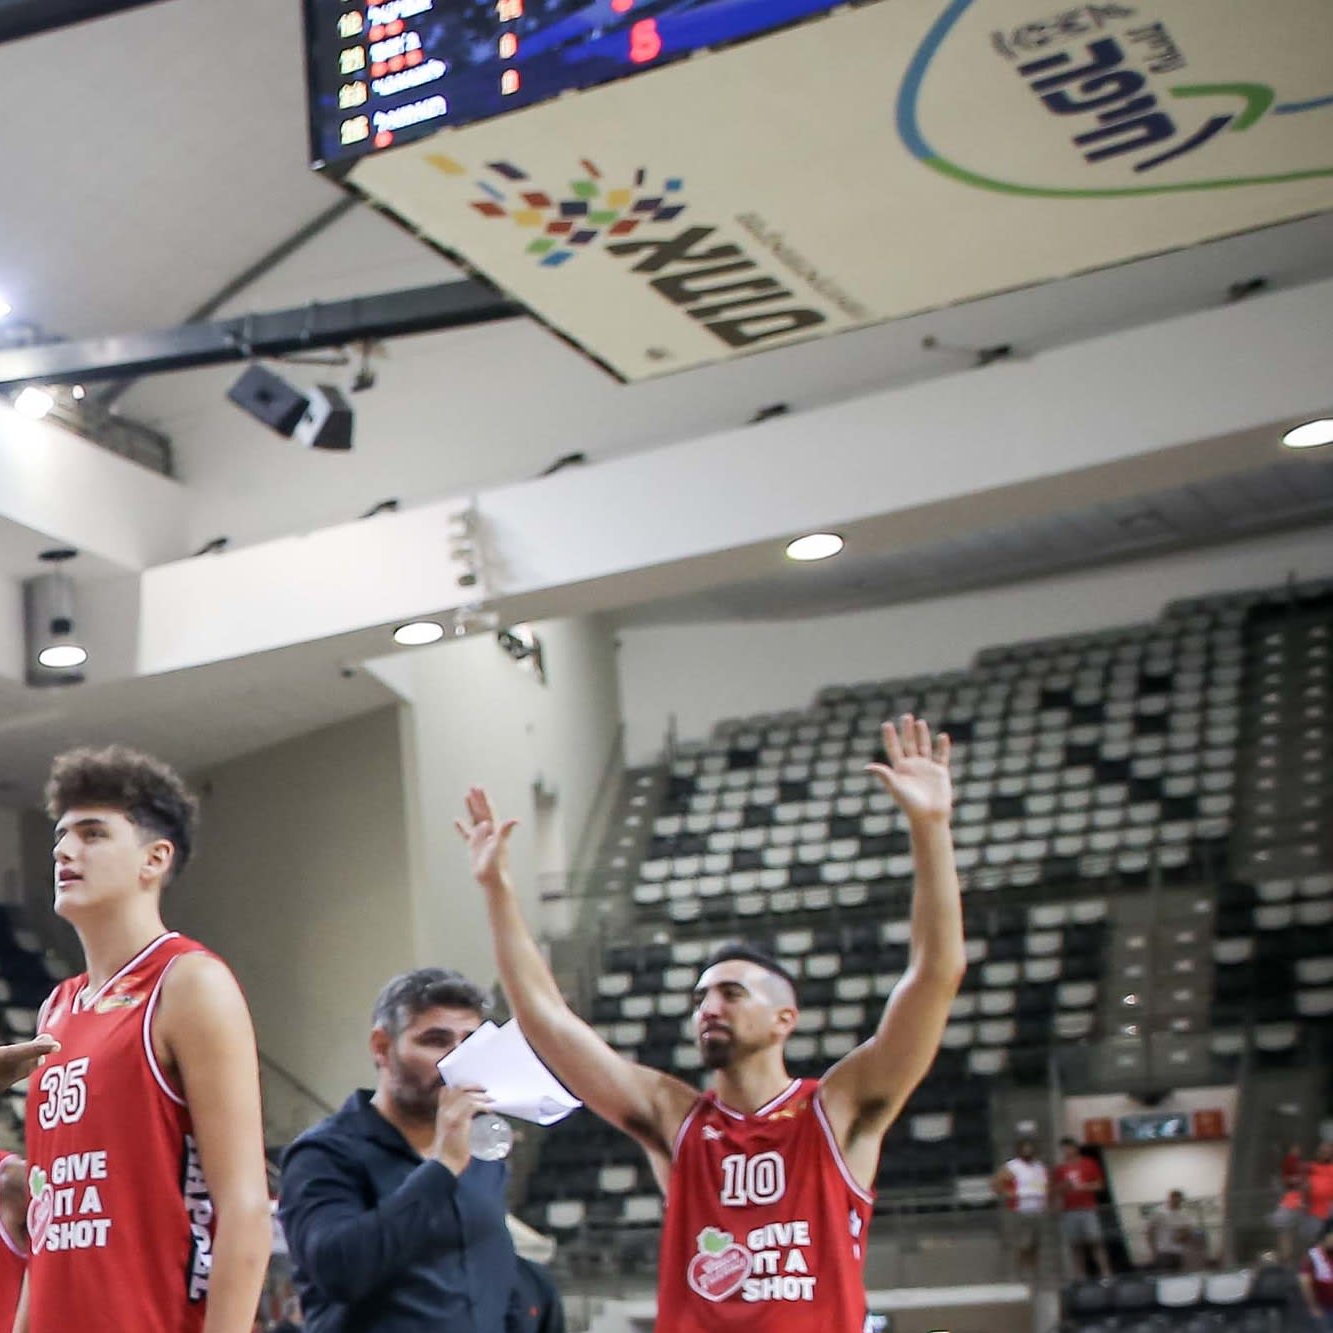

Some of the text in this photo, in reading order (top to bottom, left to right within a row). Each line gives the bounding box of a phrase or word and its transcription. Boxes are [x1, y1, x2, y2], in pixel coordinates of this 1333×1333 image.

[1017, 36, 1178, 165] חיפה
[604, 225, 827, 349] אתוס
[37, 1056, 91, 1131] 35
[50, 1149, 108, 1186] GIVE
[720, 1150, 787, 1208] 10
[53, 1185, 104, 1218] IT A
[45, 1218, 112, 1252] SHOT
[746, 1220, 812, 1251] GIVE
[751, 1250, 782, 1276] IT
[784, 1249, 808, 1275] A
[741, 1276, 817, 1303] SHOT
